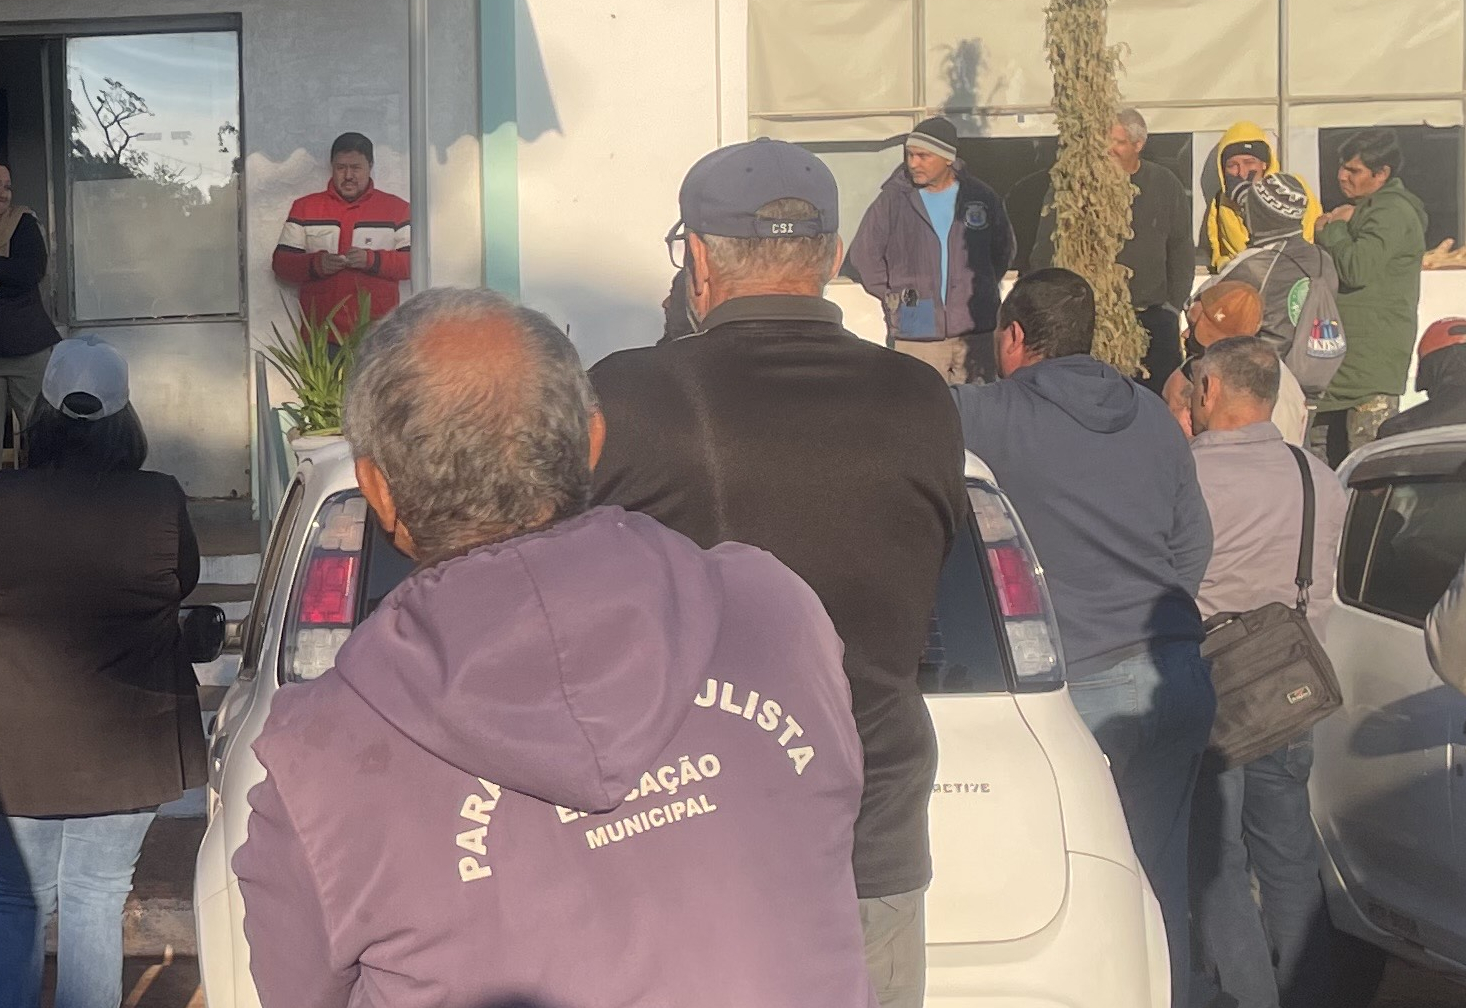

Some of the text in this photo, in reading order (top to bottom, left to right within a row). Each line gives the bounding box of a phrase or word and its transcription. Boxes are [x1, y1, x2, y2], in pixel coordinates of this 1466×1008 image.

[772, 223, 794, 234] CSI
[555, 753, 722, 824] EAÇÃO
[585, 794, 718, 850] MUNICIPAL
